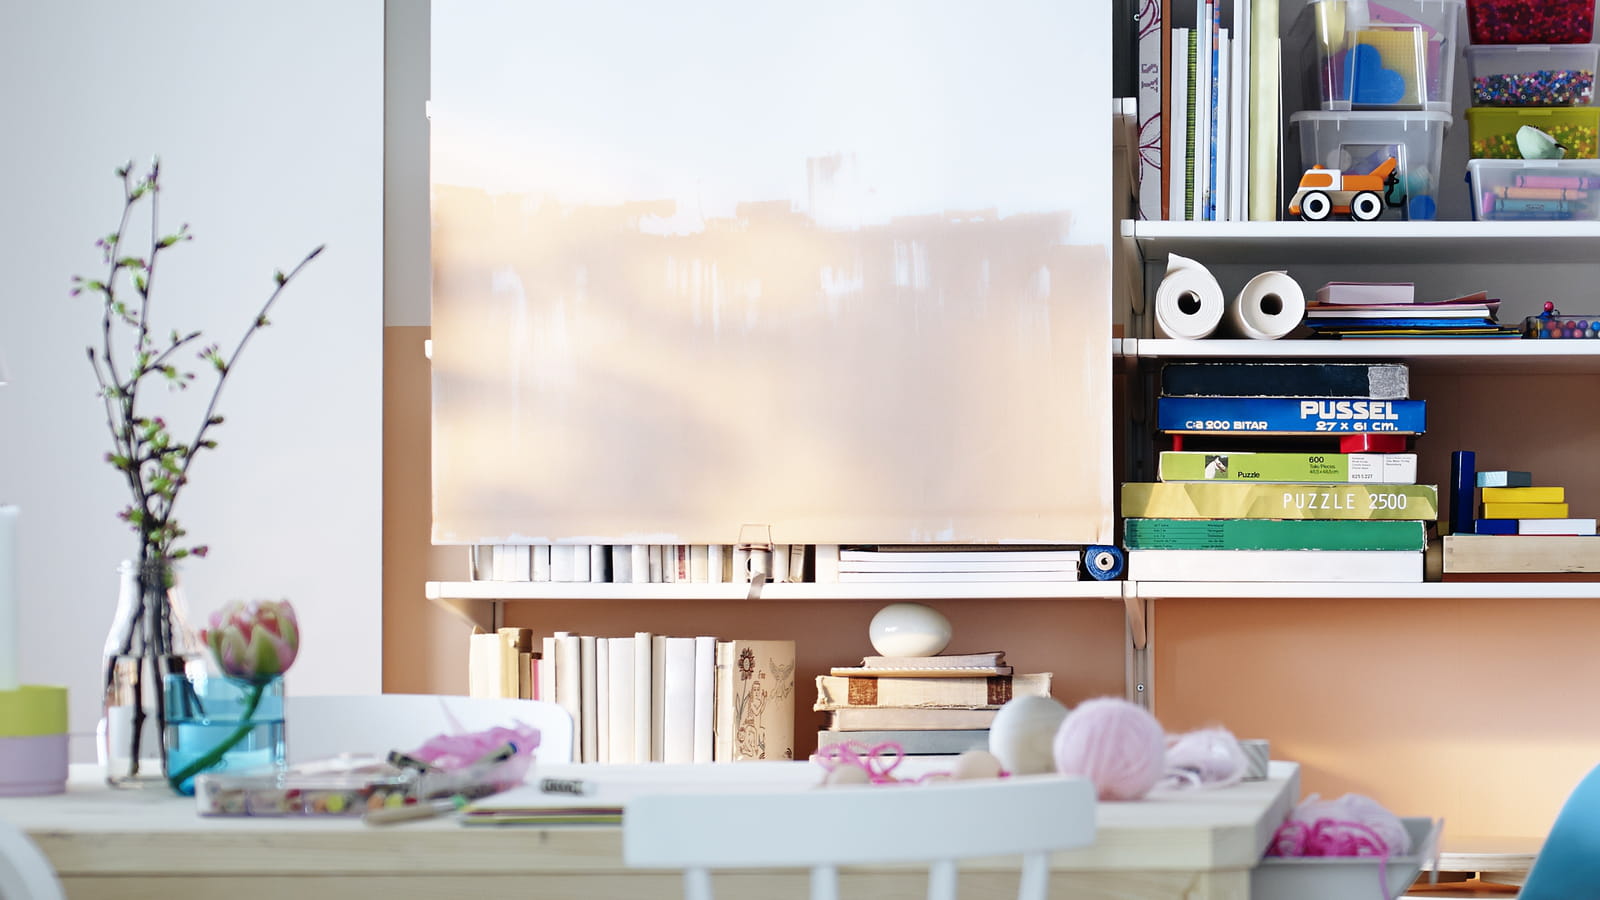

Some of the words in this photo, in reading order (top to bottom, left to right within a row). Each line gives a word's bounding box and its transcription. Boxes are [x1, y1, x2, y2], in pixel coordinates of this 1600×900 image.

[1300, 401, 1399, 420] PUSSEL
[1205, 420, 1231, 430] 200
[1233, 421, 1268, 430] BITAR
[1315, 421, 1338, 432] 27
[1353, 422, 1368, 432] 61
[1308, 456, 1325, 464] 600
[1237, 471, 1260, 479] Puzzle
[1283, 493, 1356, 510] PUZZLE
[1368, 493, 1407, 510] 2500
